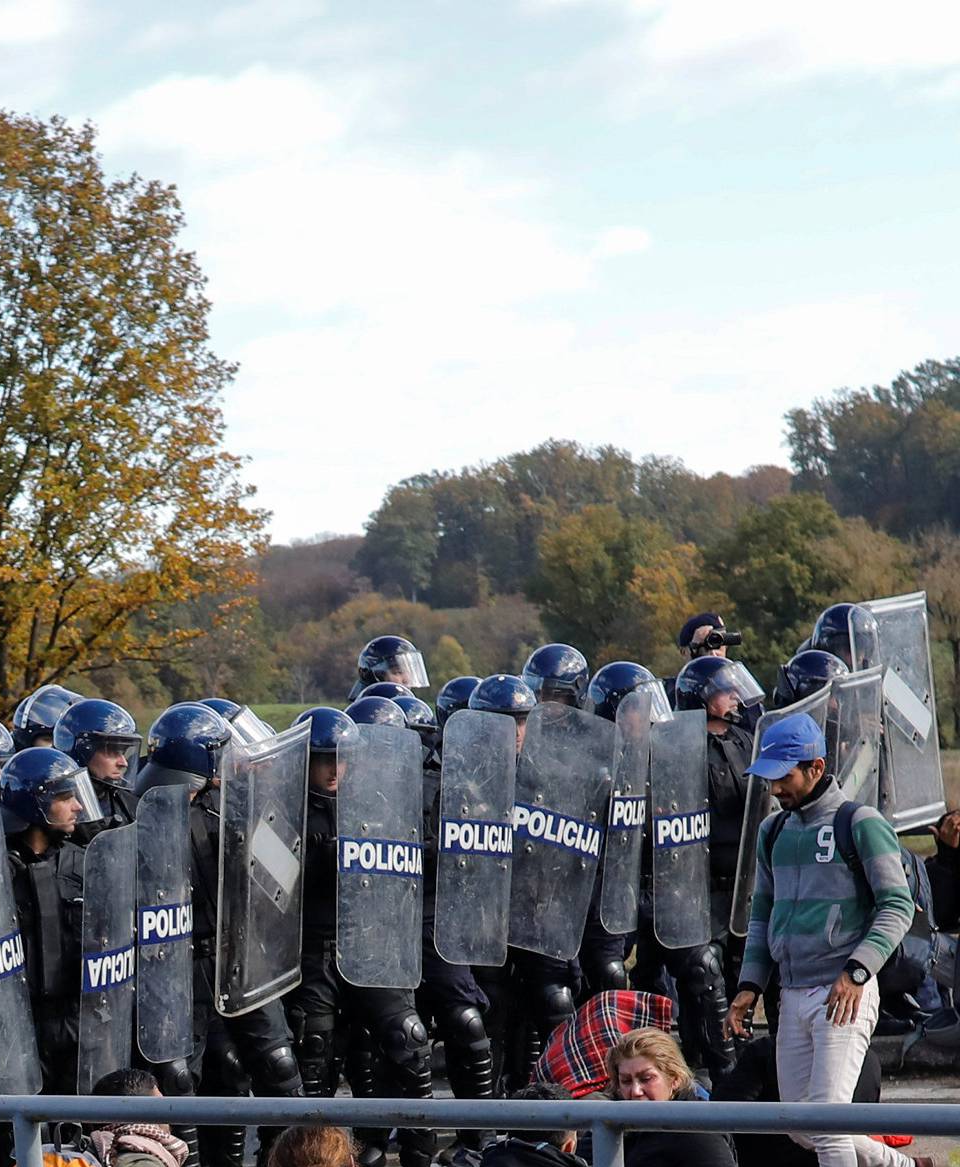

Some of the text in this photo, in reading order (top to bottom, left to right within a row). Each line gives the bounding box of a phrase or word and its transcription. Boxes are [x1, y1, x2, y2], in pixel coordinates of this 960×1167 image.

[512, 805, 601, 857] POLICIJA
[816, 825, 836, 863] 9
[343, 841, 423, 875] POLICIJA
